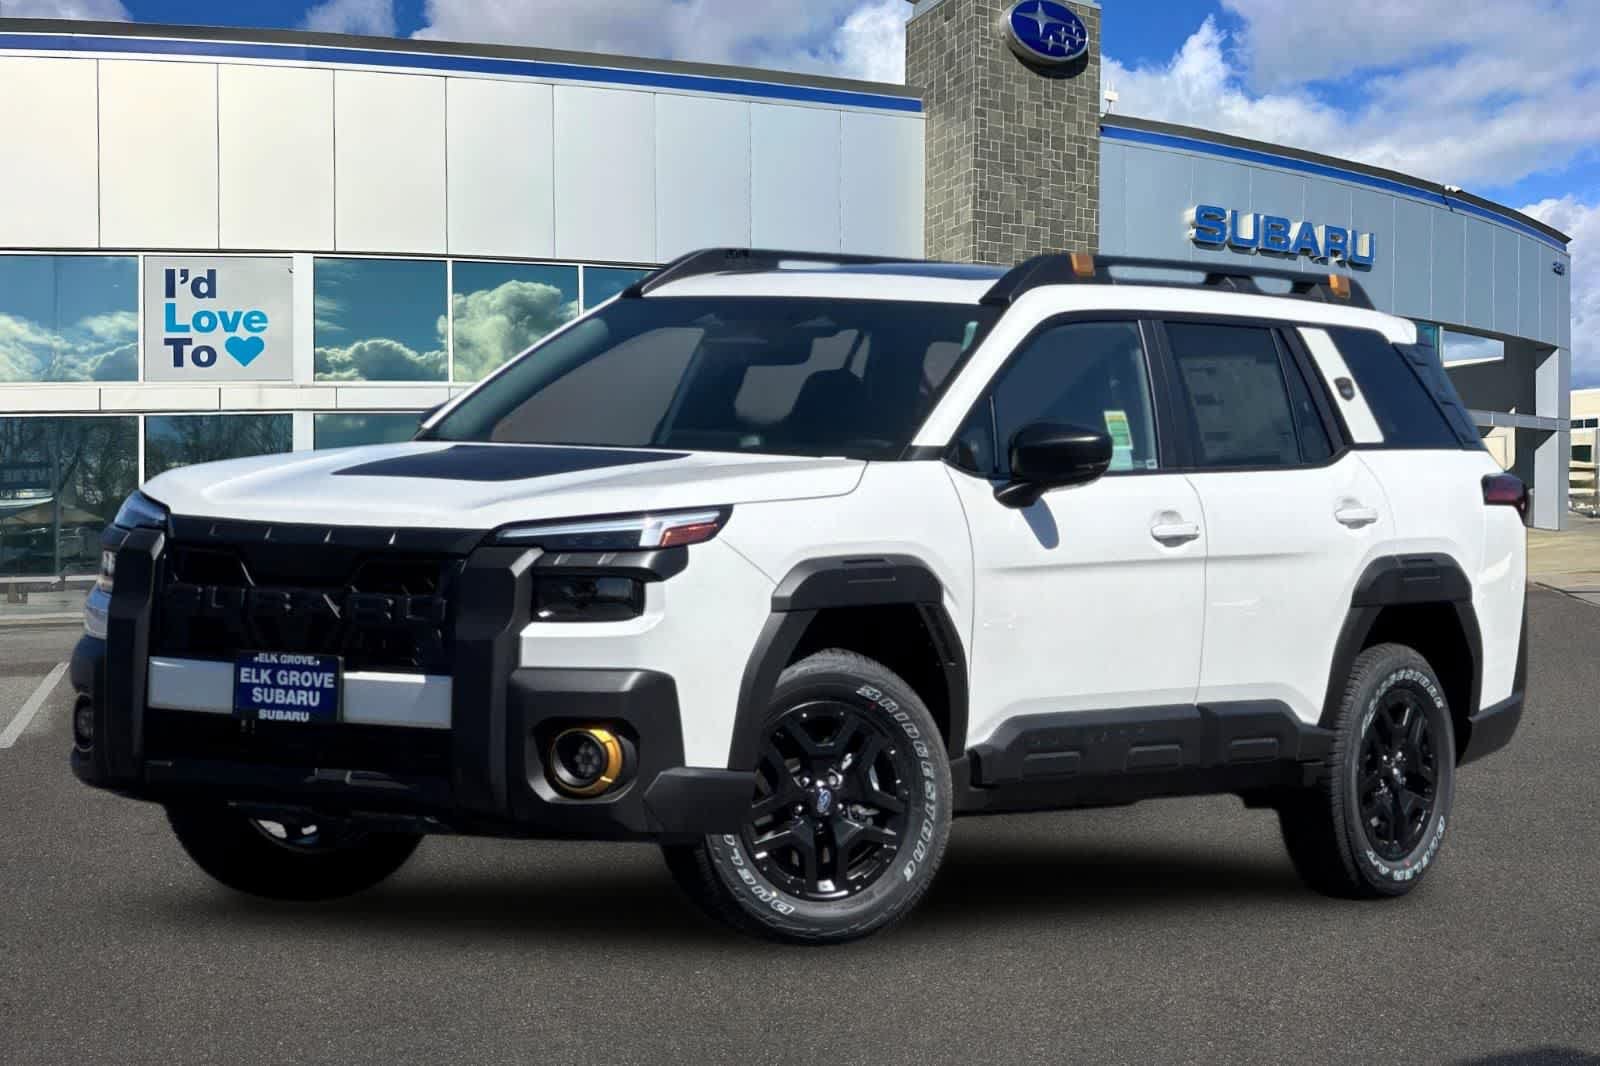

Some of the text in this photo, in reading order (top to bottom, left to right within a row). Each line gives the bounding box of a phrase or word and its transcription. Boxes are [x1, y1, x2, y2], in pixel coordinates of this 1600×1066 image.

[1191, 204, 1377, 268] SUBARU
[164, 302, 268, 333] Love
[164, 337, 217, 368] To
[240, 667, 335, 688] ELK GROVE
[252, 687, 321, 707] SUBARU
[258, 709, 310, 722] SUBARU
